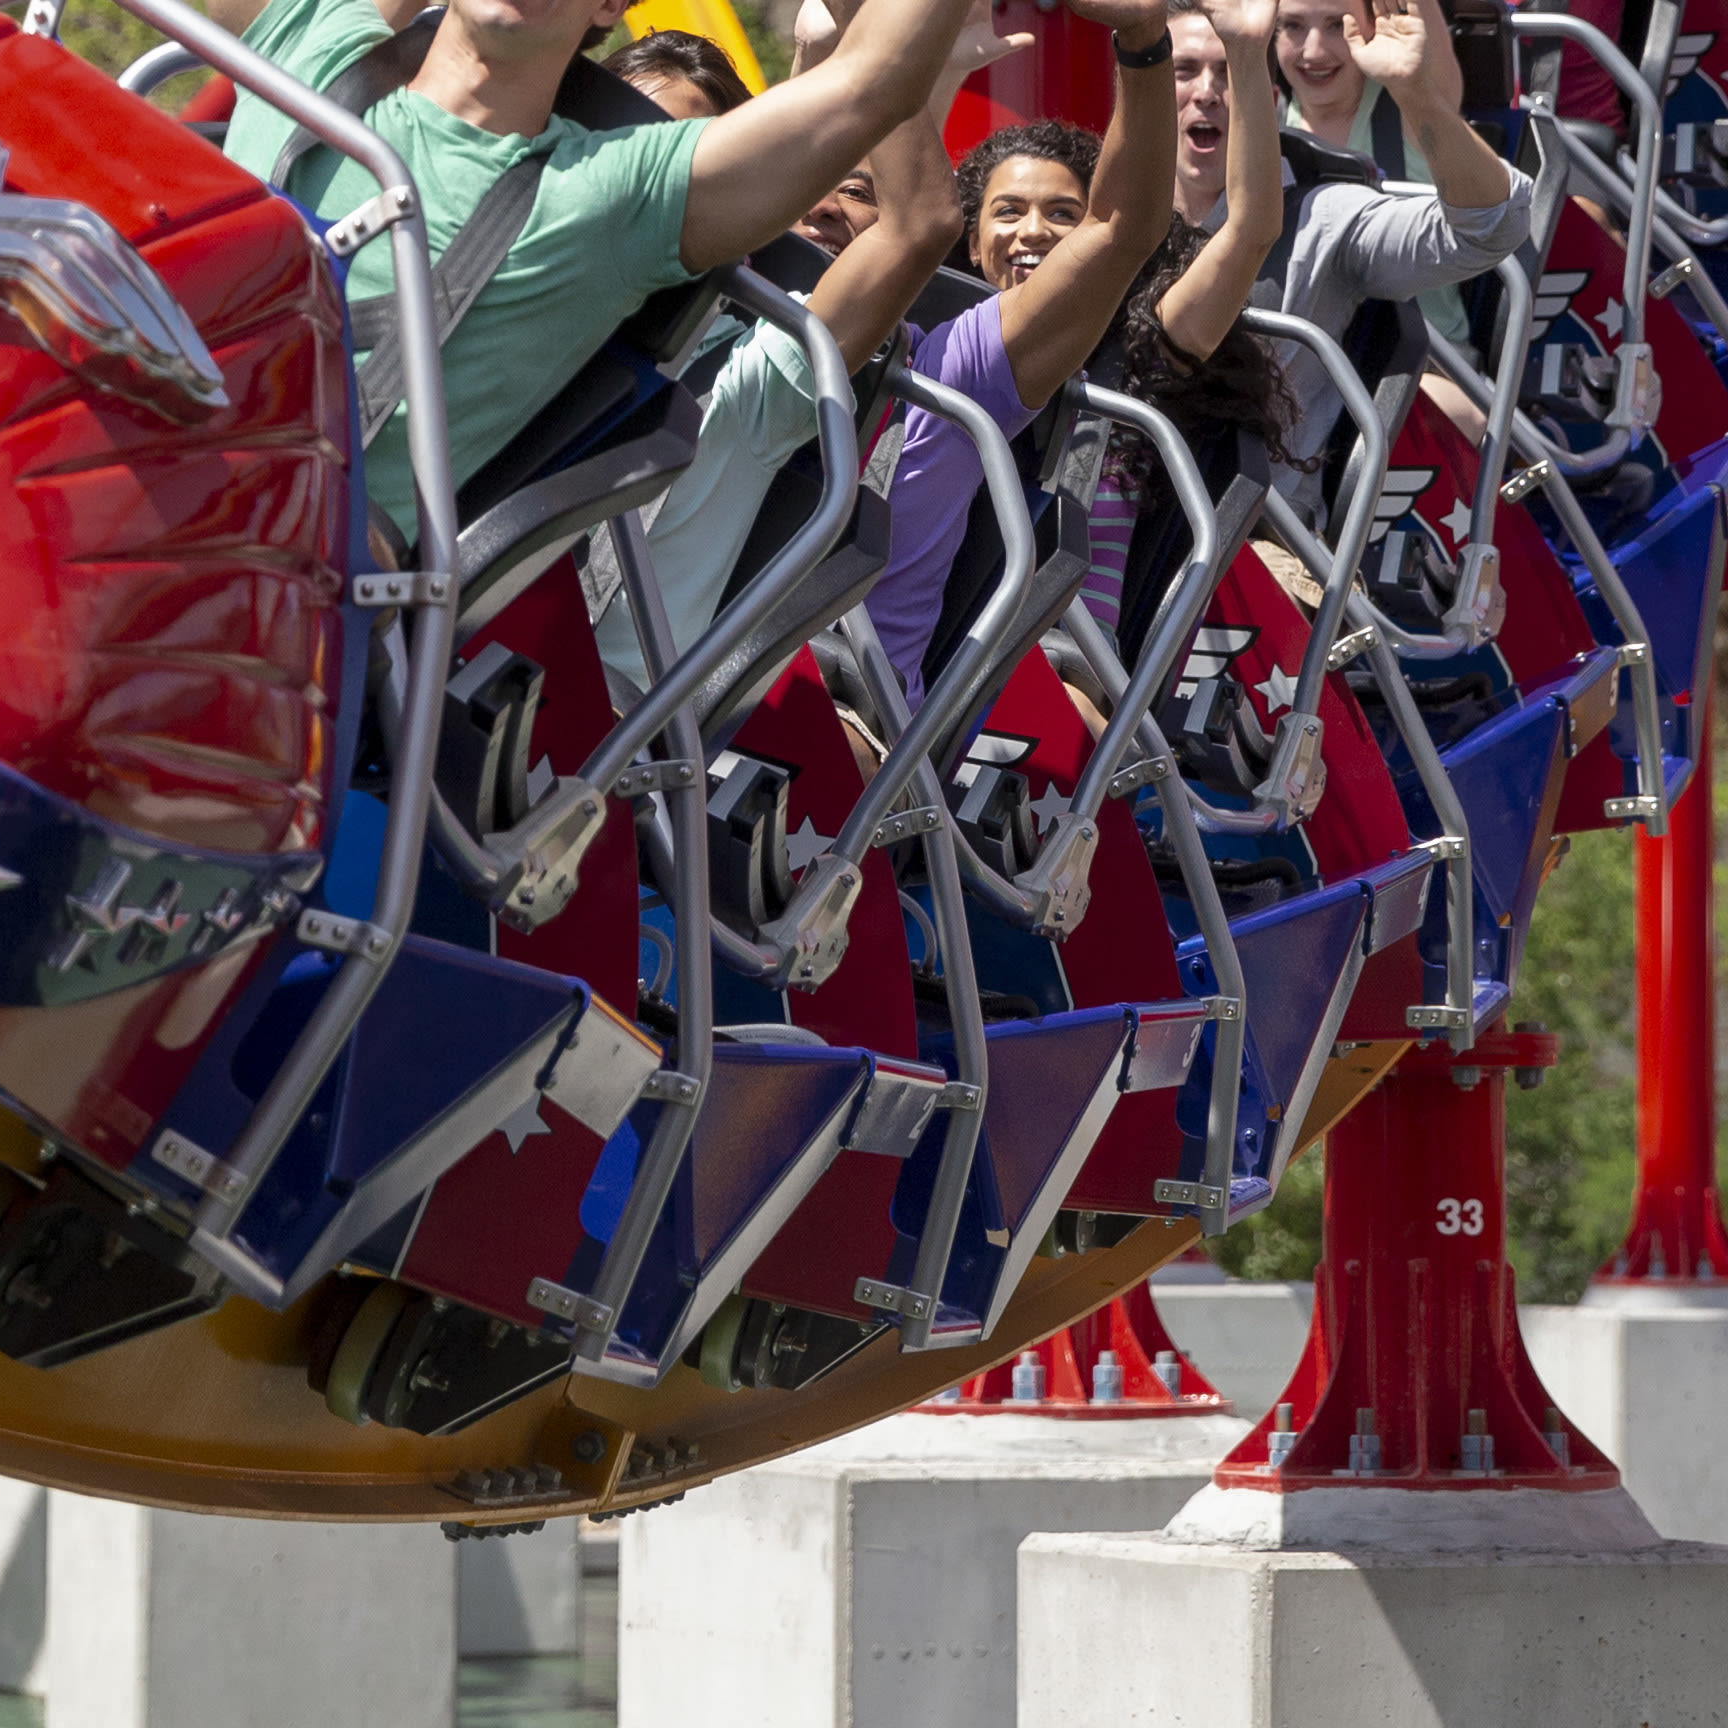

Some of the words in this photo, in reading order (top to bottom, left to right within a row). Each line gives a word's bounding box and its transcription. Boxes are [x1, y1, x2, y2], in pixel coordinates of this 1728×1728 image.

[1182, 1023, 1201, 1068] 3
[908, 1093, 937, 1139] 2
[1435, 1198, 1484, 1235] 33
